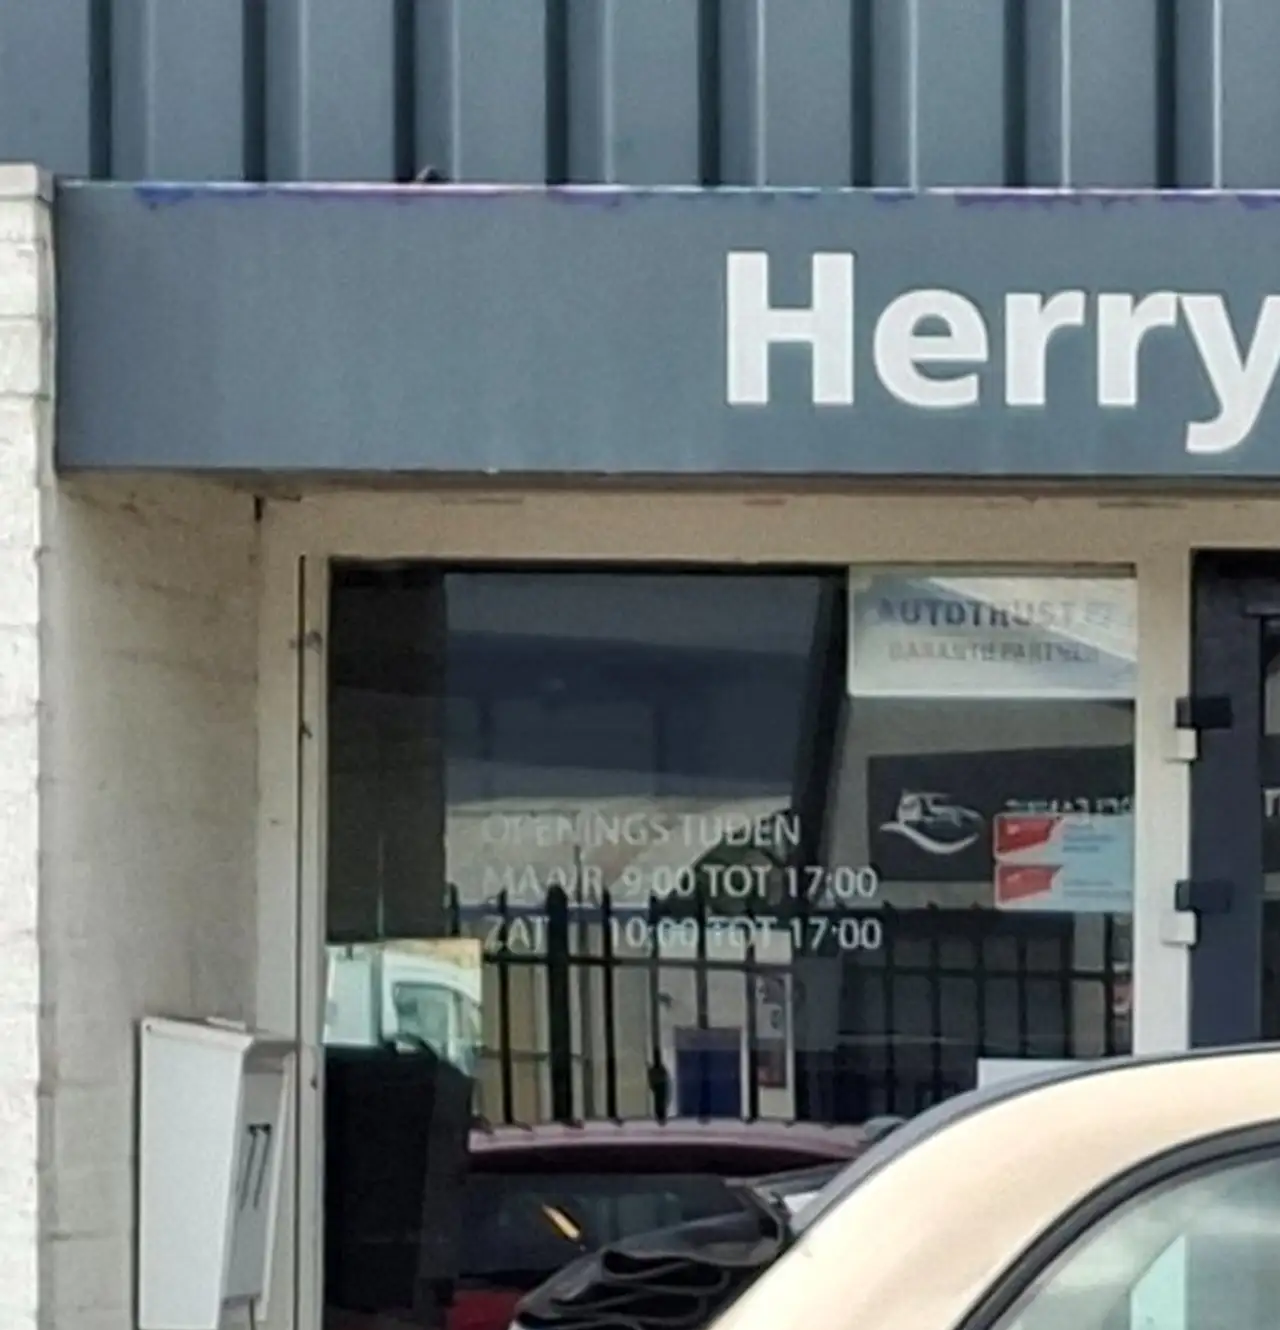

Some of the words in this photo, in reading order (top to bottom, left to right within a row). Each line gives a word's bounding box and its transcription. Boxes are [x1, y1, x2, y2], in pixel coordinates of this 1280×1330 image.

[704, 866, 772, 897] TOT
[784, 866, 879, 898] 17:00
[705, 915, 777, 950] TOT
[792, 915, 882, 950] 17:00
